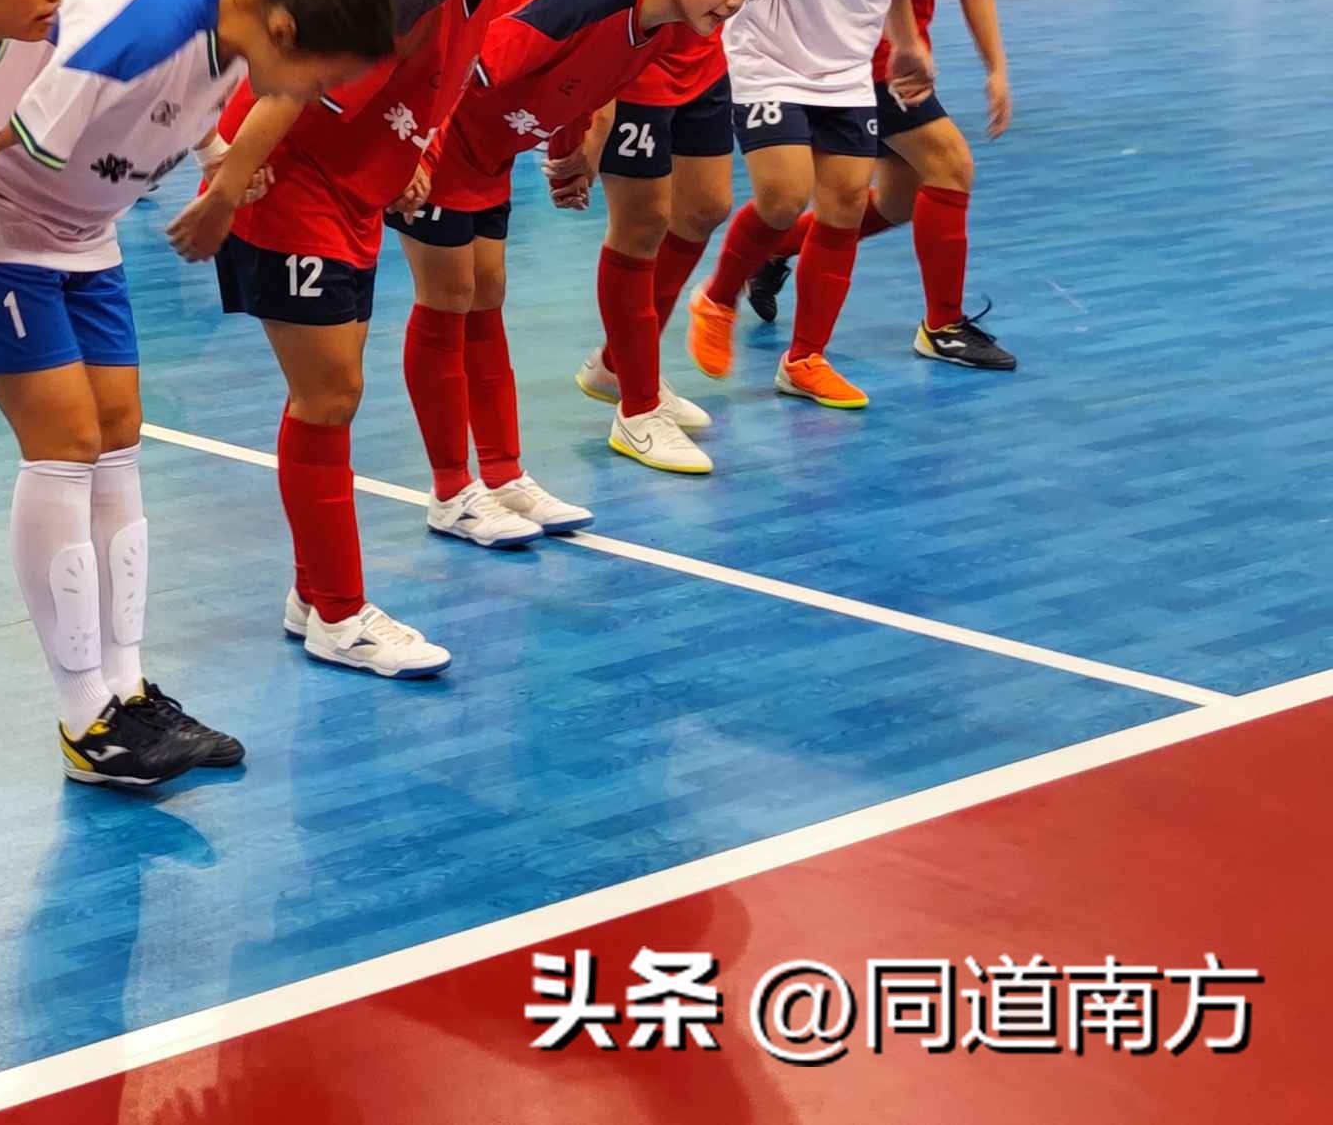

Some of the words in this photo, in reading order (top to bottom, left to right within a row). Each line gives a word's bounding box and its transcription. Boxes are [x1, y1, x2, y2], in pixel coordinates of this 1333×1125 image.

[745, 101, 783, 130] 28
[617, 122, 656, 159] 24
[285, 254, 324, 297] 12
[3, 290, 27, 340] 1
